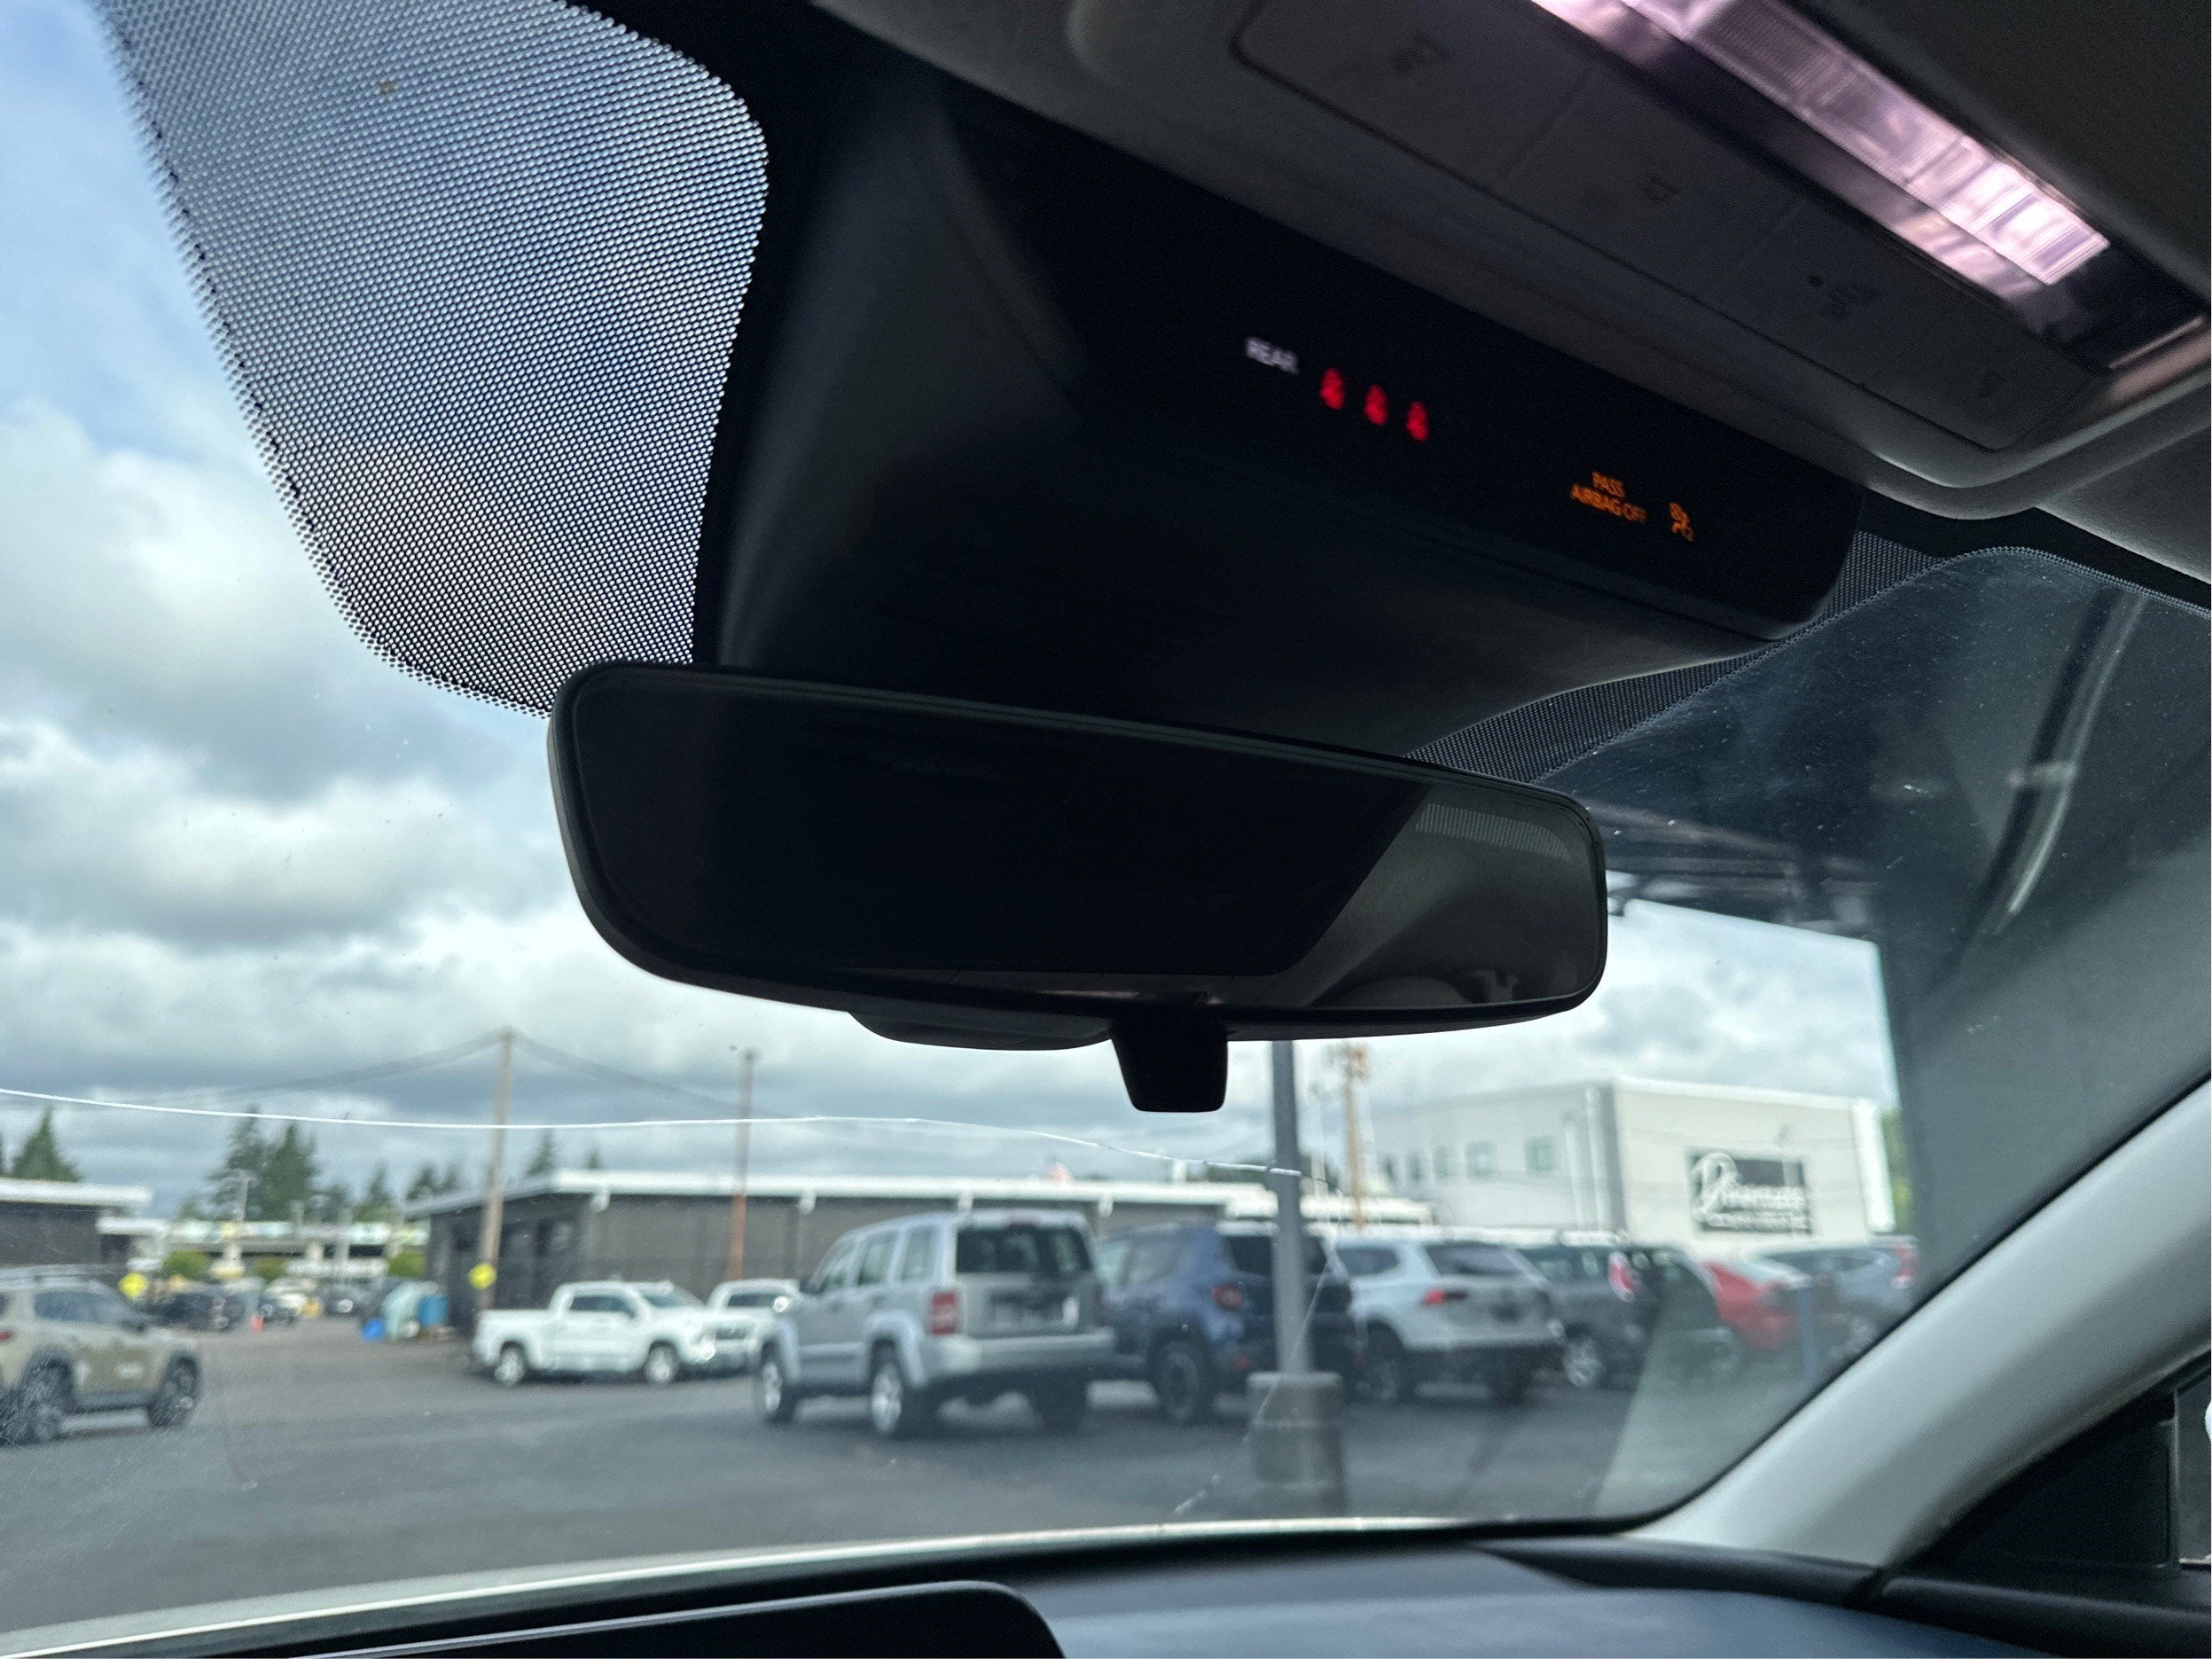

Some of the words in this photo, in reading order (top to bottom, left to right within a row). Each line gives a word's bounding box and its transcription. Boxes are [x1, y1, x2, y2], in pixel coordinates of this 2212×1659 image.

[1246, 337, 1298, 372] REAR
[1591, 471, 1625, 497] PASS
[1570, 484, 1622, 517] AIRBAG
[1622, 502, 1646, 521] OFF
